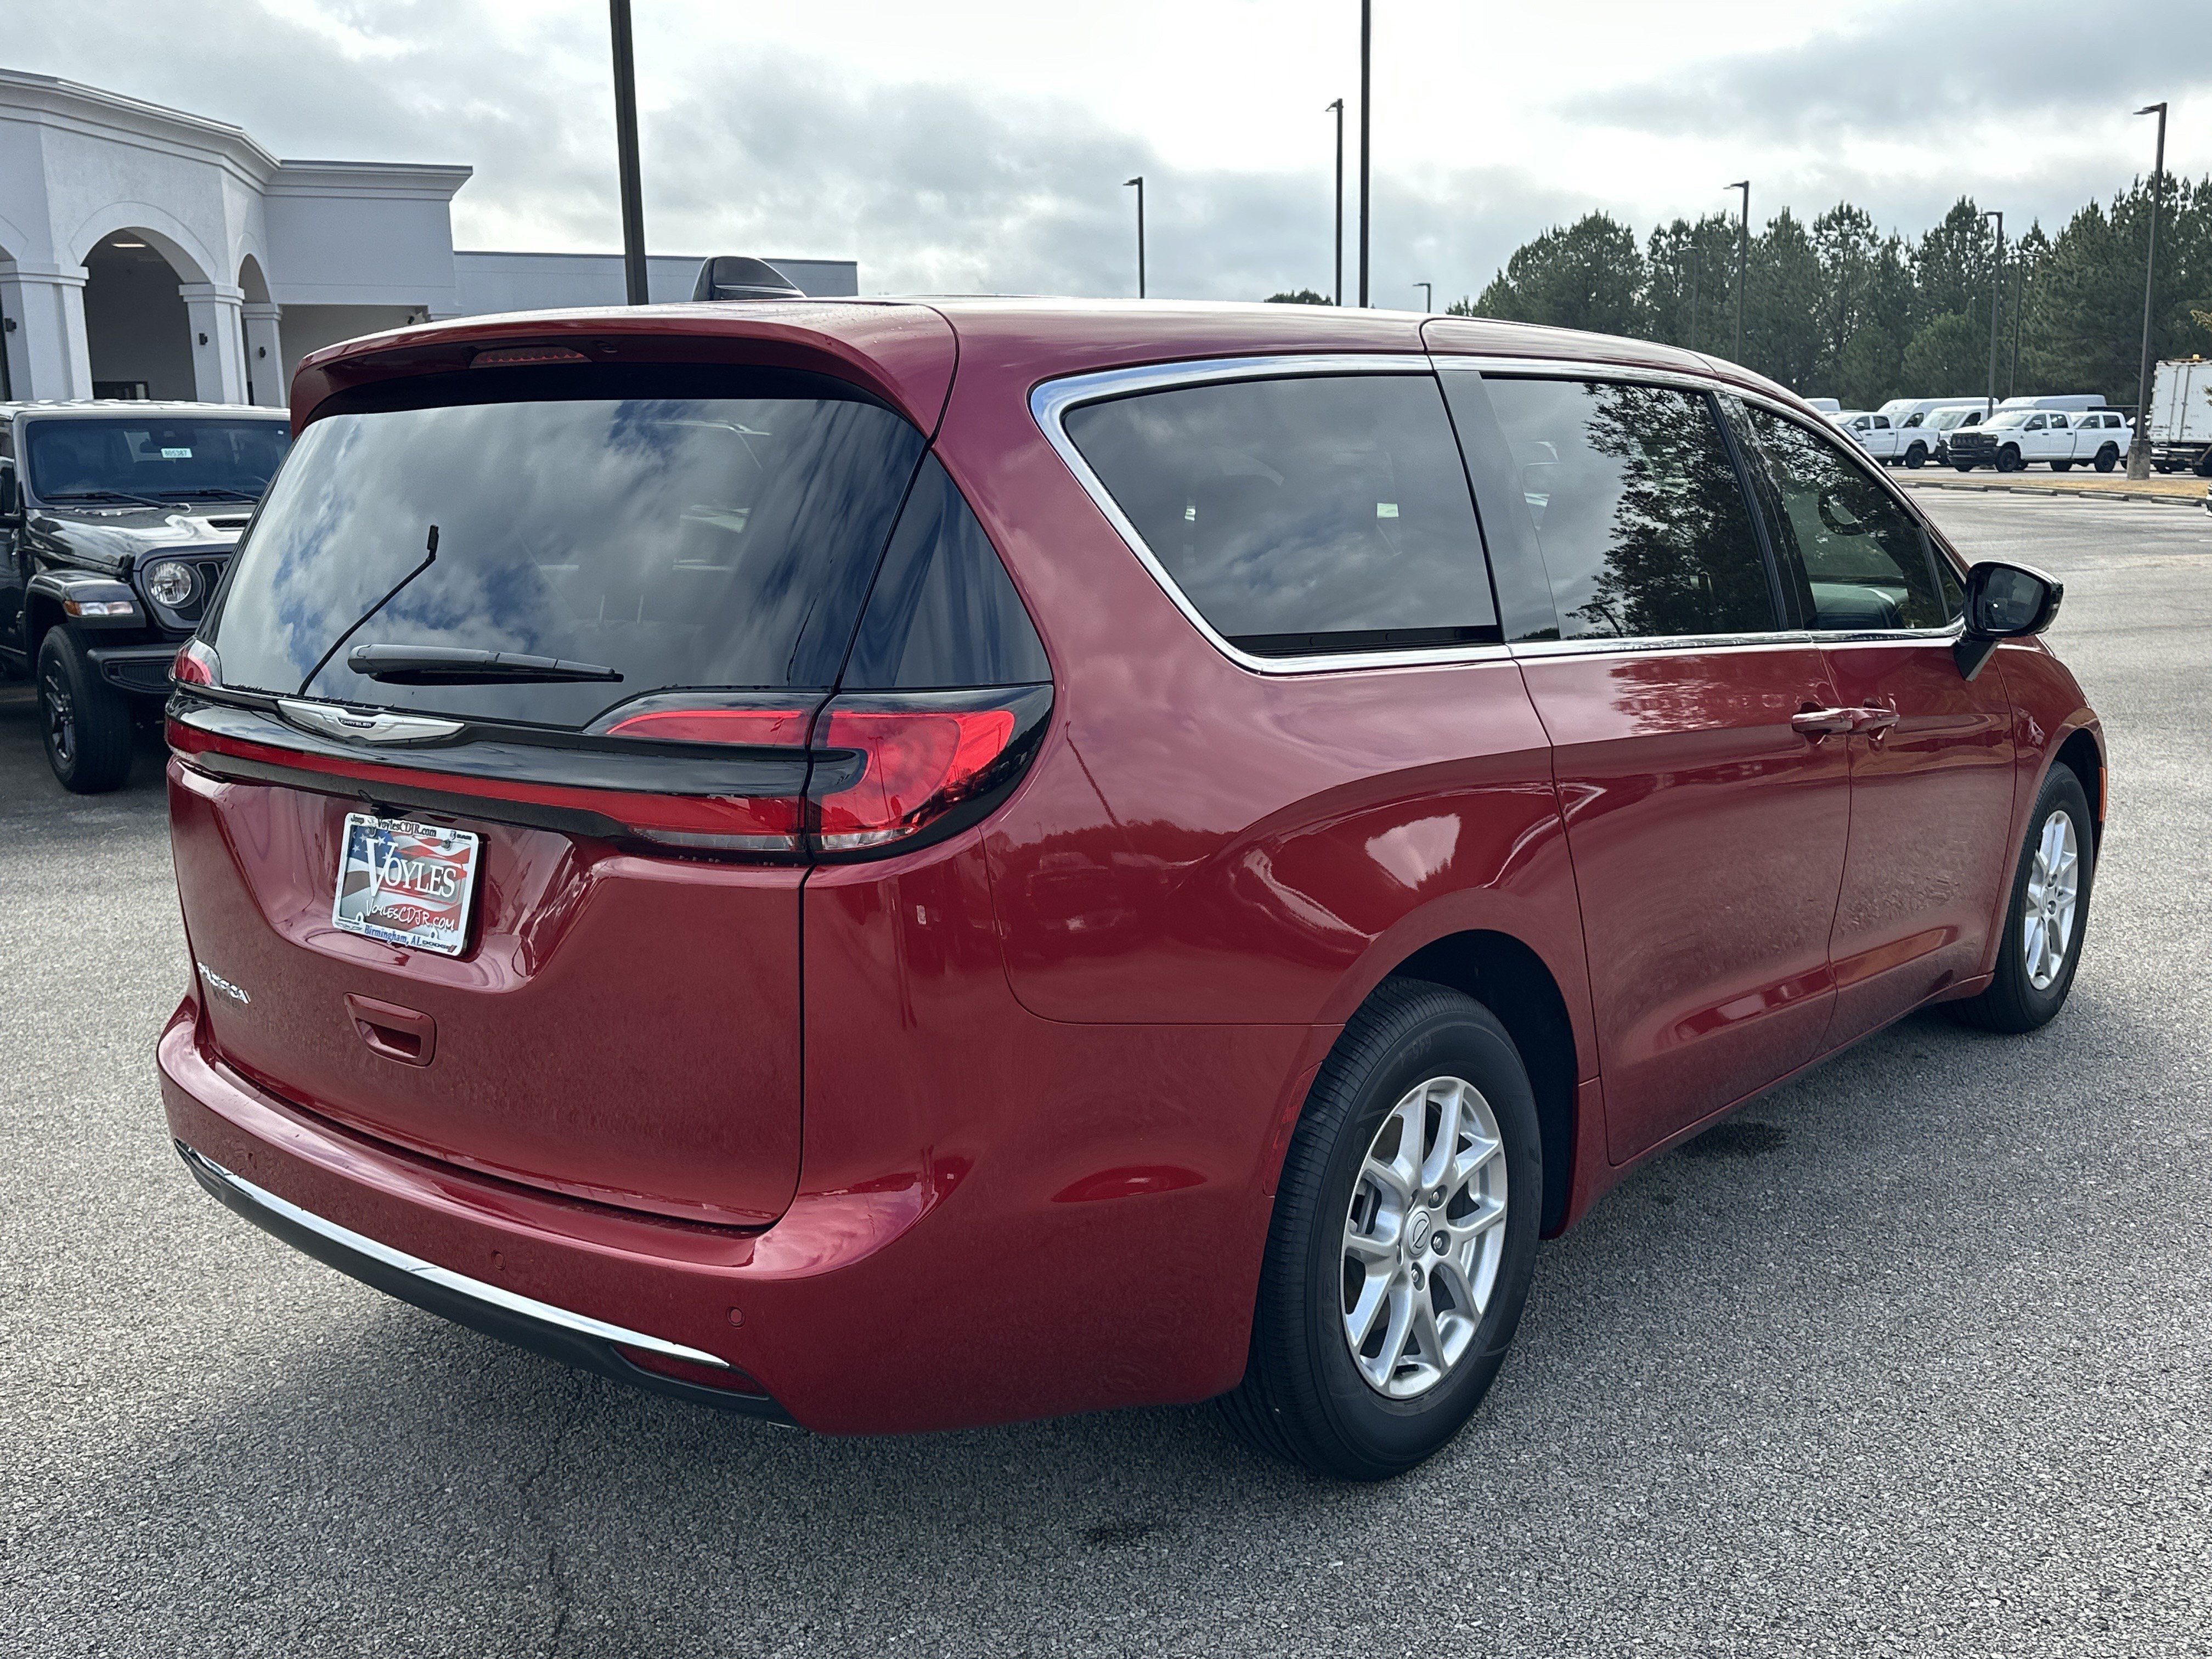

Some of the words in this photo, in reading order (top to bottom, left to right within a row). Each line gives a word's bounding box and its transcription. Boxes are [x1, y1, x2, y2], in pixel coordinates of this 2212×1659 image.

[377, 817, 437, 837] VoylesCDJR.com
[366, 838, 456, 898] VOYLES
[364, 924, 409, 945] Birmingham,
[411, 935, 422, 946] AL
